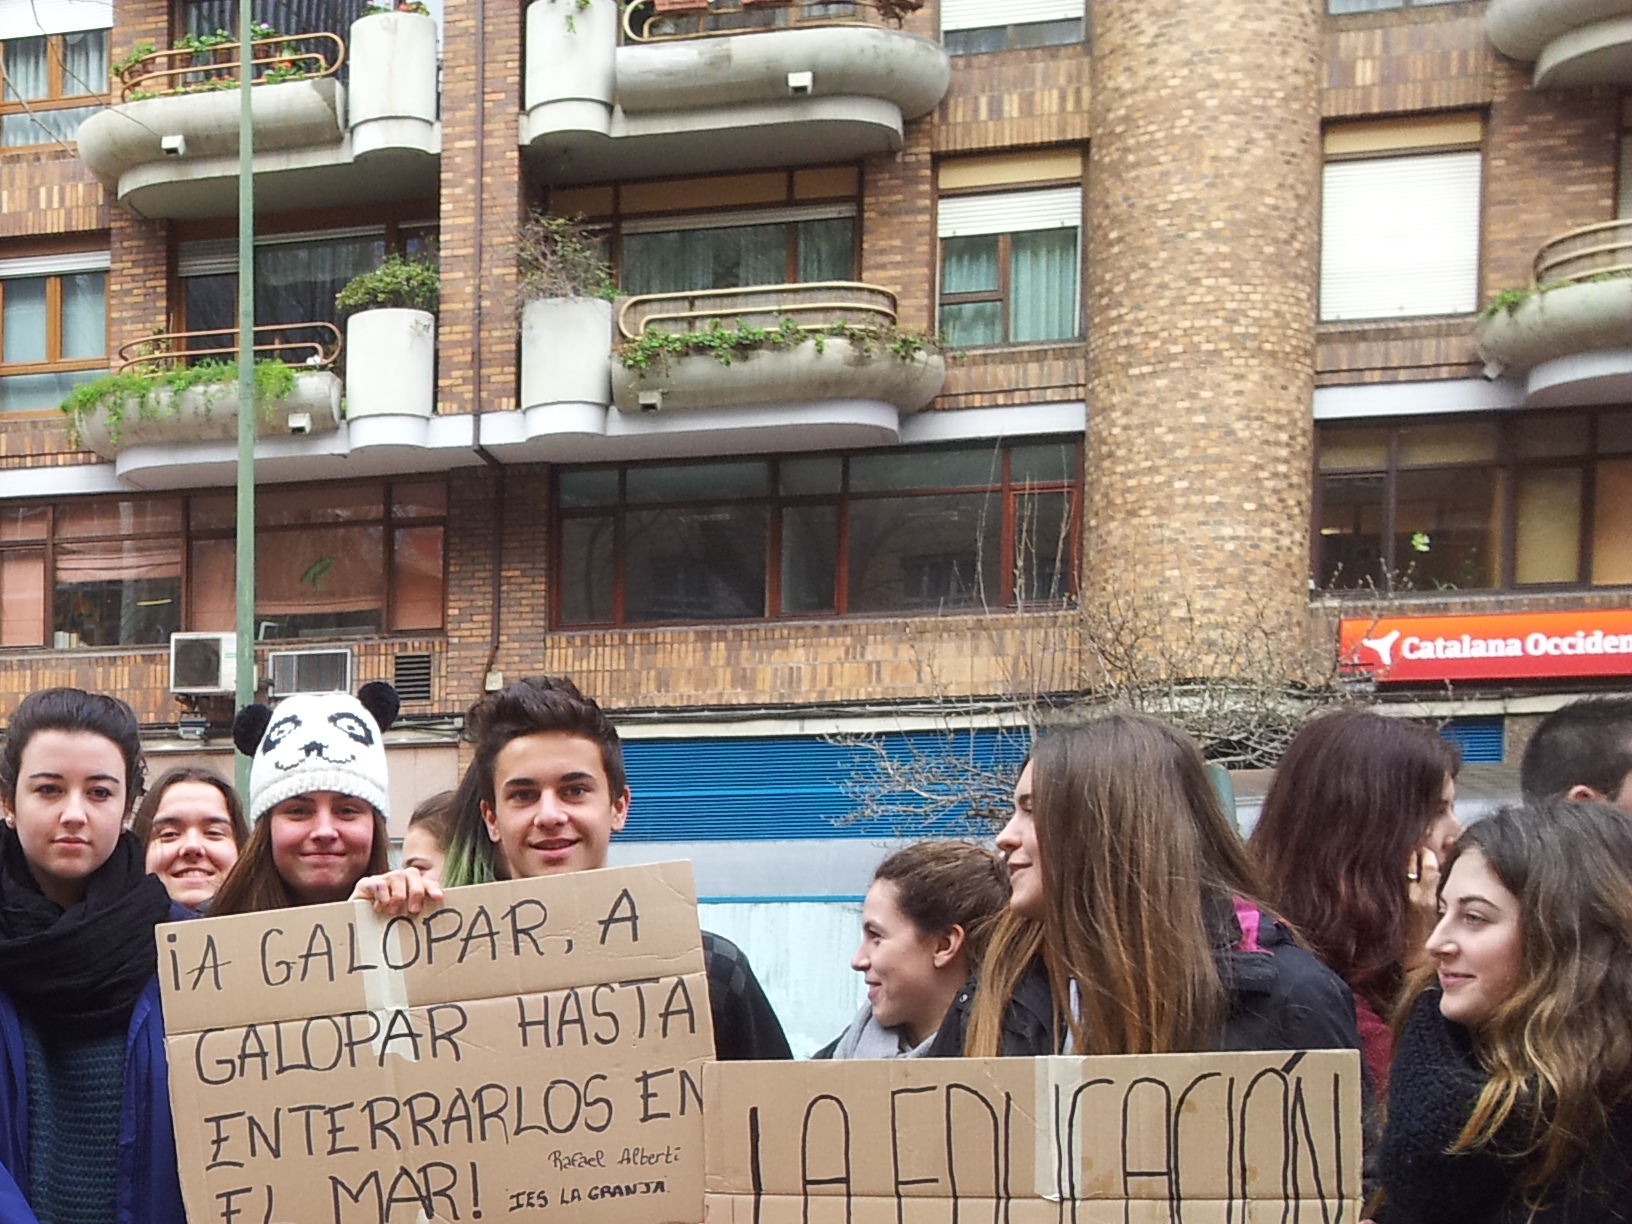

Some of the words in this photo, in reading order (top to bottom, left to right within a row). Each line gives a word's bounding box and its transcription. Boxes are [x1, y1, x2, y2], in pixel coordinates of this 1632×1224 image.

[1401, 634, 1523, 660] Catalana
[261, 899, 574, 986] GALOPAR,
[598, 888, 639, 945] A
[195, 1003, 467, 1085] GALOPAR
[517, 977, 695, 1048] HASTA
[204, 1074, 613, 1172] ENTERRARLOS
[548, 1150, 605, 1171] Rafael
[618, 1146, 681, 1165] Alberti
[508, 1190, 549, 1212] IES
[560, 1187, 582, 1205] LA
[588, 1180, 666, 1201] GRANJA
